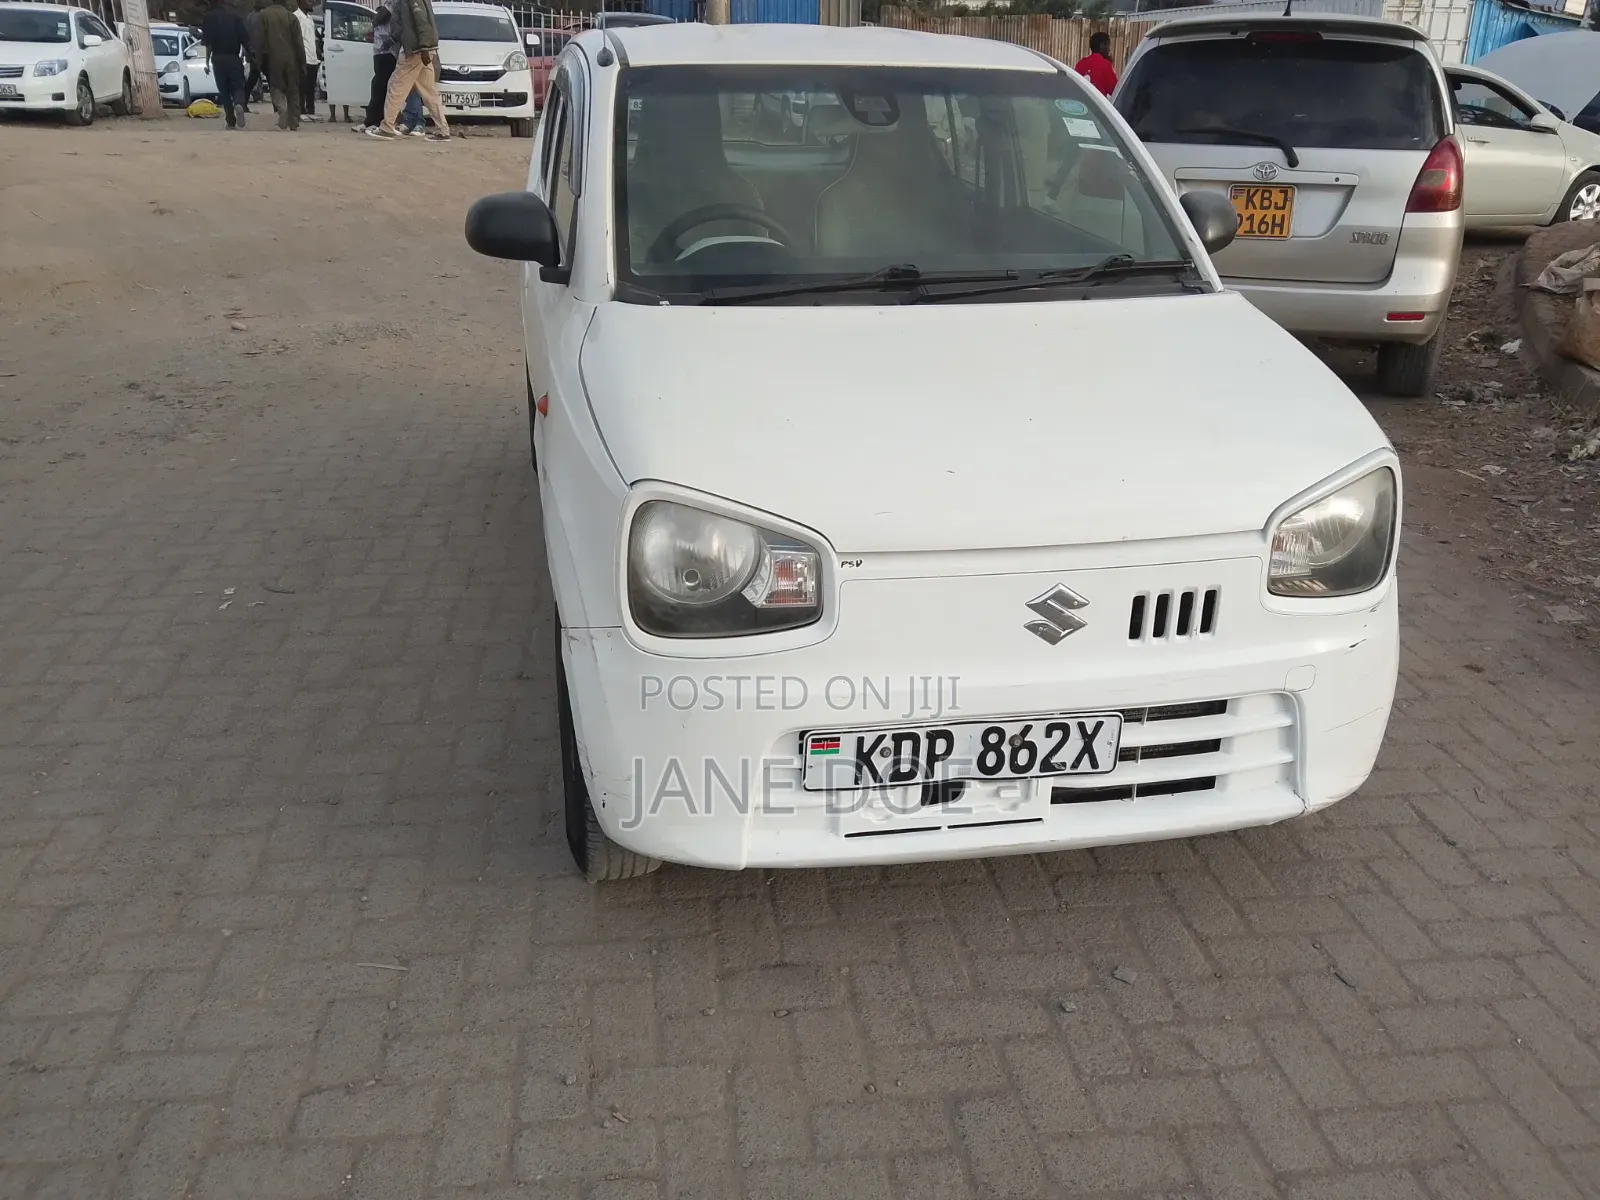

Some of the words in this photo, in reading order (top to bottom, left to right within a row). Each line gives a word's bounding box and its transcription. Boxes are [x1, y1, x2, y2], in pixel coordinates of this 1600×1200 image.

[439, 94, 452, 103] DM
[1245, 188, 1289, 210] KBJ
[853, 728, 954, 785] KDP
[976, 720, 1104, 776] 862X
